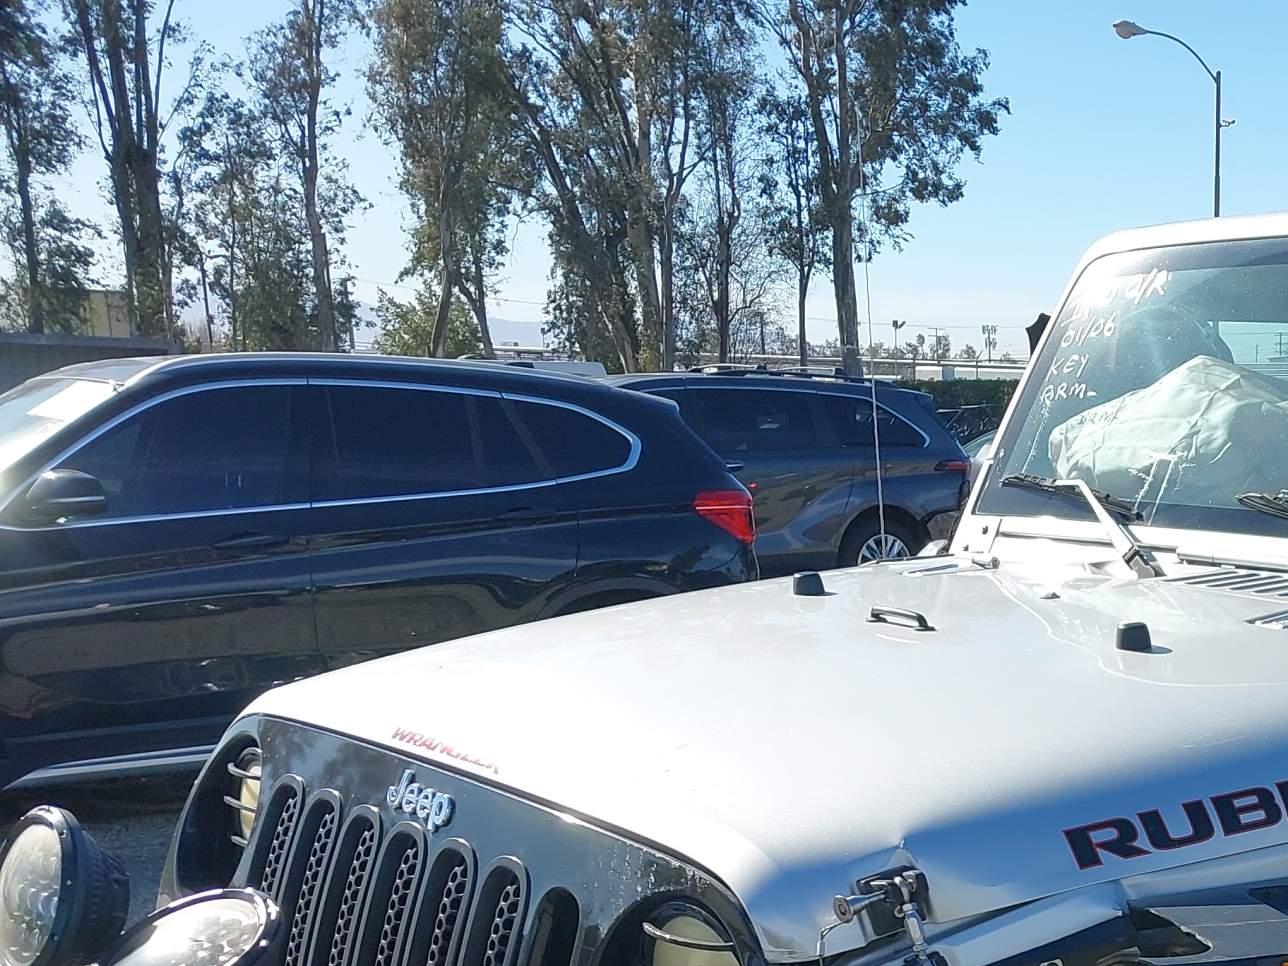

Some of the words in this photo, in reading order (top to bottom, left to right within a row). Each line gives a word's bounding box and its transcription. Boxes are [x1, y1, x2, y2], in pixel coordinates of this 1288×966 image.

[1061, 312, 1116, 347] 01/06
[1046, 354, 1089, 382] KEY
[386, 769, 455, 833] Jeep
